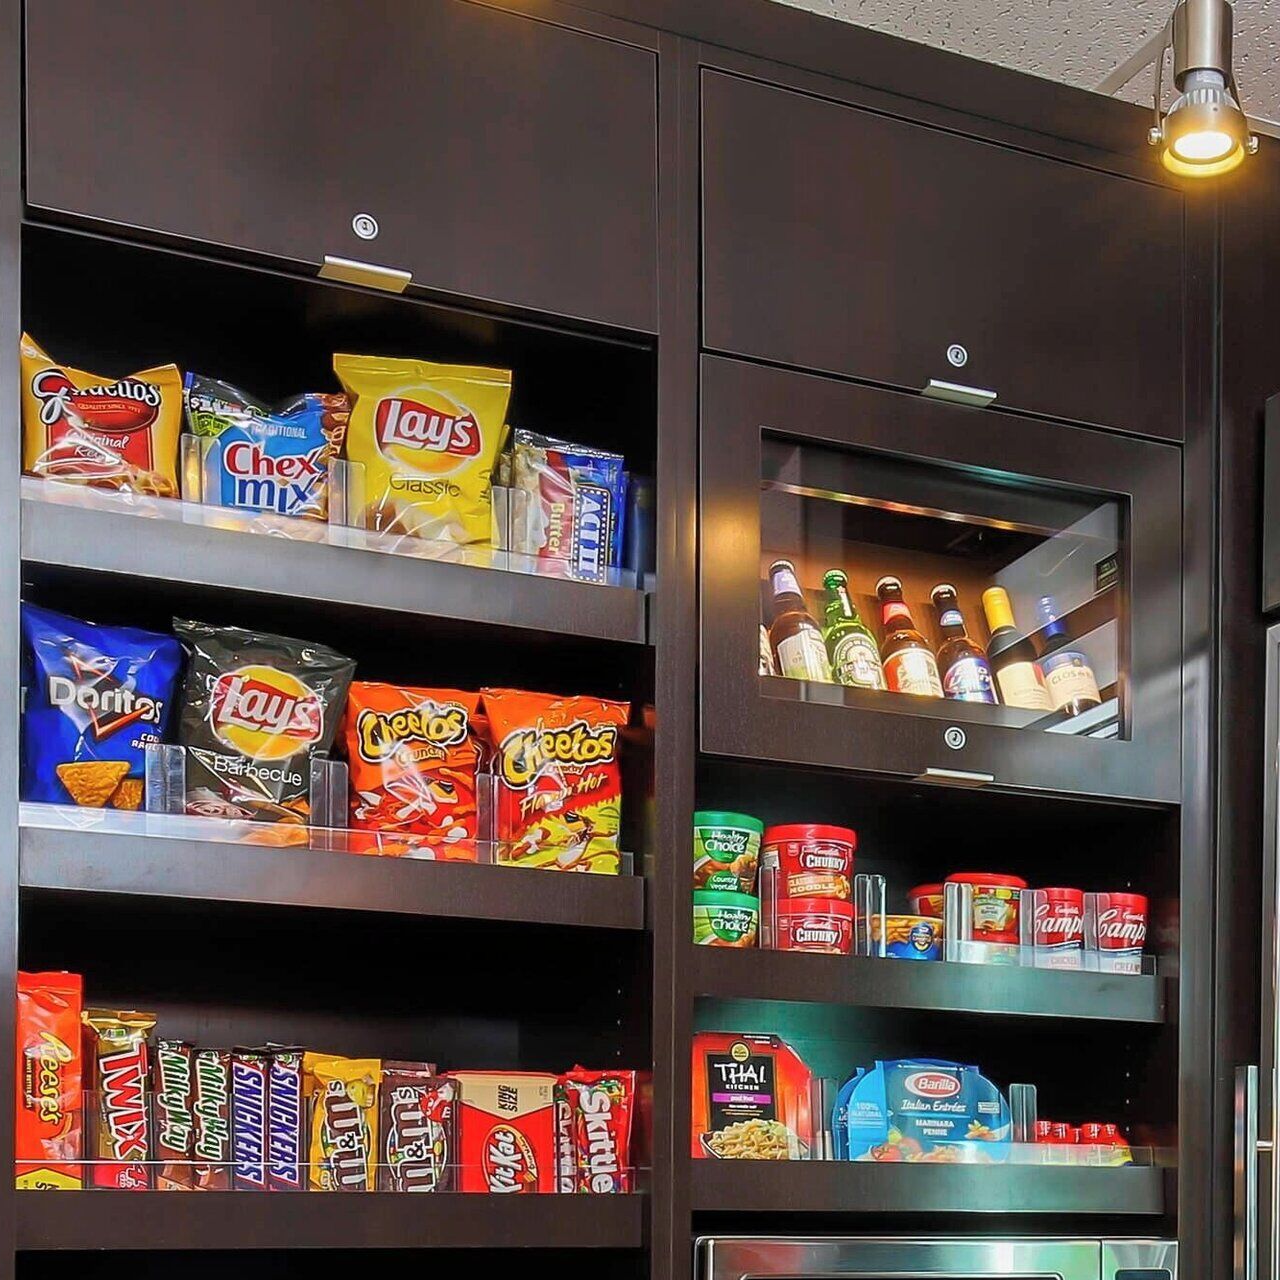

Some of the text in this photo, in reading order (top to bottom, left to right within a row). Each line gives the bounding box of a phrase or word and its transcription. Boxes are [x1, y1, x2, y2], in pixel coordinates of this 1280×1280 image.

[381, 400, 475, 453] Lay's
[223, 440, 321, 477] Chex
[237, 476, 318, 513] mix
[389, 476, 462, 498] Classic
[548, 502, 566, 555] Butter
[580, 494, 602, 541] ACT
[49, 676, 163, 724] Doritos
[217, 677, 315, 733] Lay's
[360, 708, 466, 757] Cheetos
[213, 756, 303, 786] Barbecue
[501, 722, 617, 786] Cheetos
[704, 838, 746, 852] Choice
[806, 854, 846, 872] CHUNKY
[790, 883, 836, 894] NOODLE
[710, 918, 750, 932] Choice
[796, 928, 838, 945] CHUNKY
[40, 1031, 73, 1125] Reese's
[713, 1062, 766, 1083] THAI
[917, 1077, 957, 1092] Barilla
[99, 1042, 148, 1161] TWIX
[498, 1084, 508, 1111] KING
[508, 1086, 519, 1113] SIZE
[900, 1099, 933, 1112] Italian
[233, 1062, 265, 1184] SNICKERS
[269, 1062, 299, 1184] SNICKERS
[580, 1090, 619, 1193] Skittle
